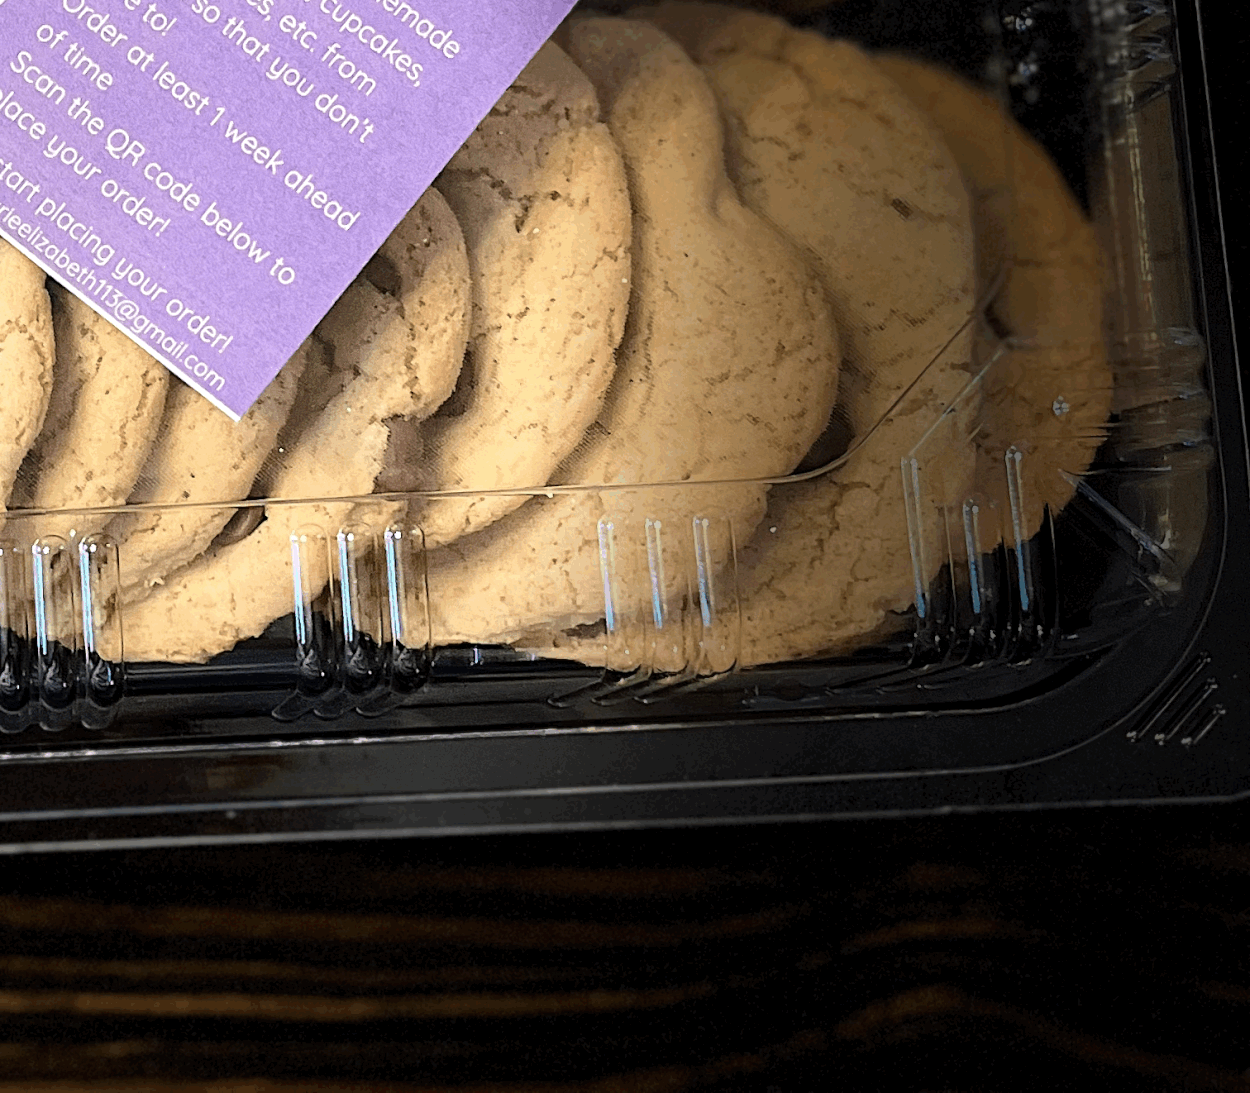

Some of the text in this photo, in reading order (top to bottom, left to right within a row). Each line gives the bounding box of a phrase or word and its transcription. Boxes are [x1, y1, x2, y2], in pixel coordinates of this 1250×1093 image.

[36, 24, 114, 91] of time
[142, 2, 178, 37] to!
[278, 14, 318, 53] etc.
[320, 42, 377, 97] from
[221, 16, 271, 63] that
[265, 56, 315, 97] you
[314, 93, 375, 144] don't
[9, 50, 296, 285] Scan the QR code below to
[42, 134, 102, 181] your
[100, 179, 172, 238] order!
[126, 45, 155, 73] at
[152, 60, 210, 116] least
[209, 106, 226, 127] 1
[224, 120, 285, 176] week
[284, 170, 362, 232] ahead
[34, 196, 116, 267] placing
[110, 257, 169, 302] your
[165, 298, 234, 354] order!
